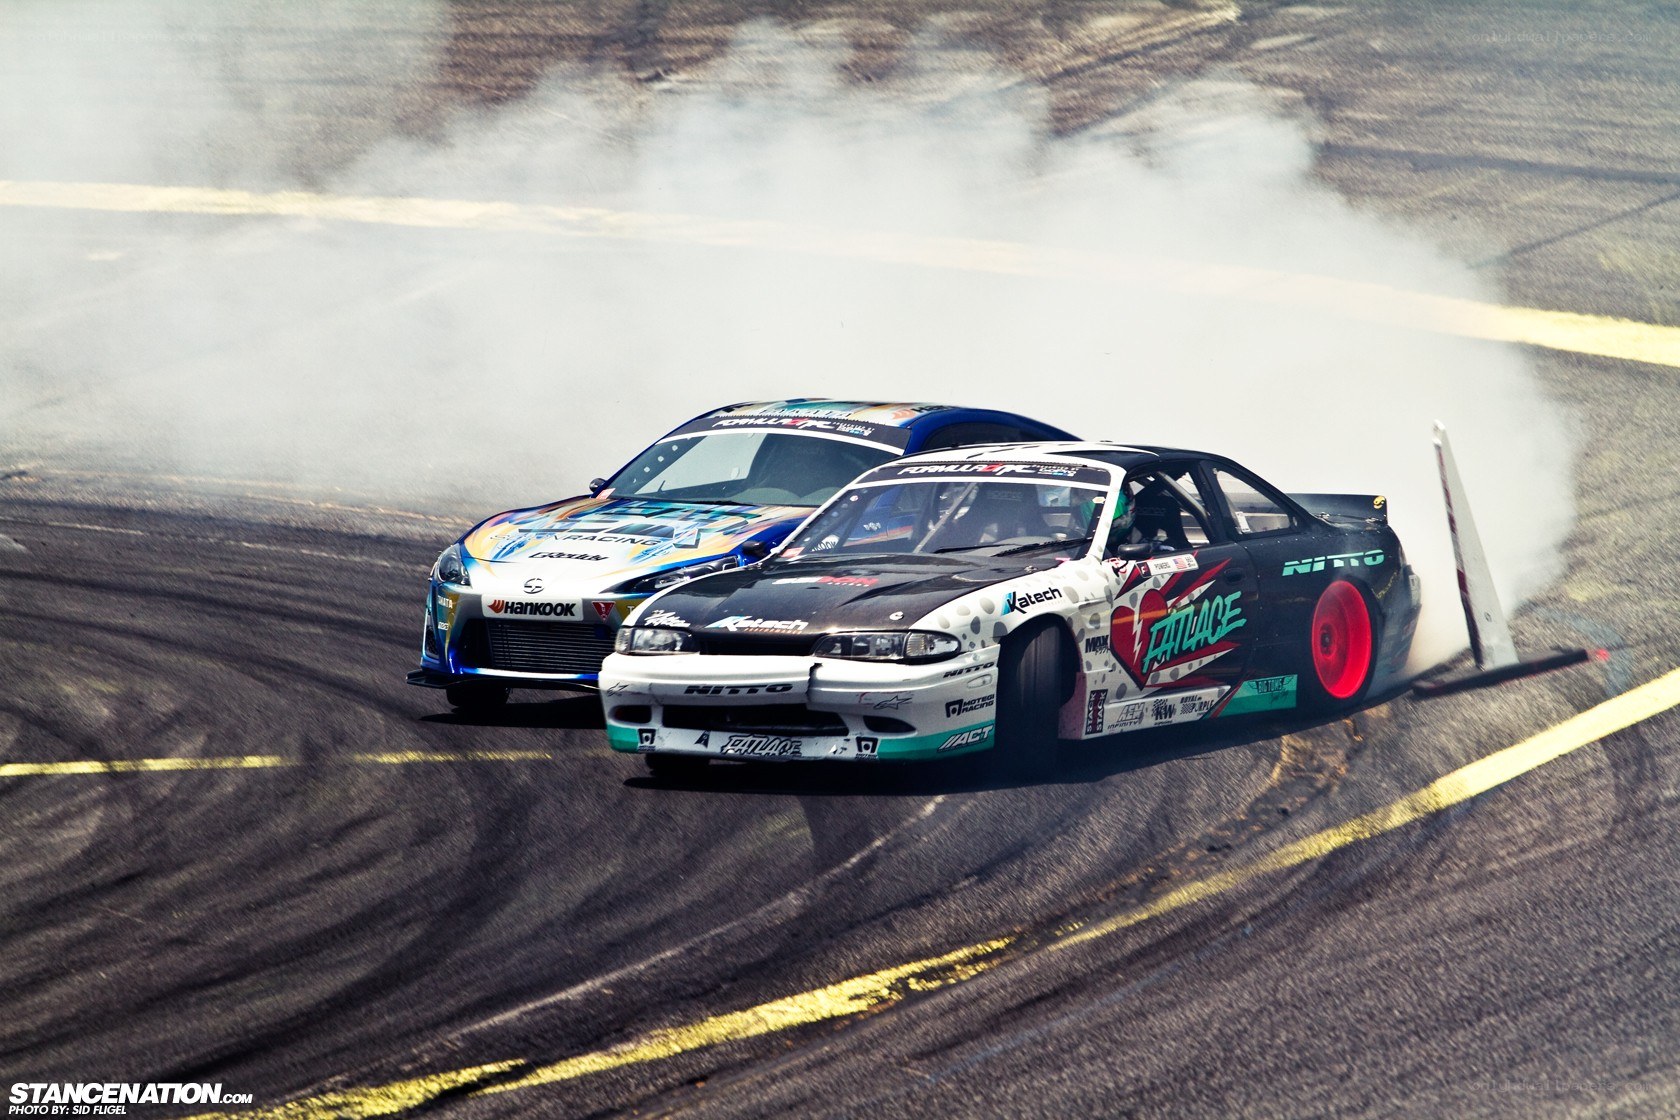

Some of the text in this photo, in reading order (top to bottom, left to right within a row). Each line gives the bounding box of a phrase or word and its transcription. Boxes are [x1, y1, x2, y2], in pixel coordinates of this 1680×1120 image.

[563, 534, 663, 547] RACING
[1282, 549, 1385, 577] NITTO
[1003, 586, 1063, 616] Katech
[716, 615, 809, 632] Katech
[1143, 590, 1247, 674] FATLACE
[1085, 634, 1110, 654] MAX
[942, 661, 995, 680] NITTO
[684, 683, 793, 695] NITTO
[961, 700, 995, 714] RACING
[963, 694, 995, 706] MOTEGI
[1180, 695, 1198, 704] ROYAL
[1086, 692, 1096, 733] STACK
[1096, 691, 1107, 732] STACK
[1117, 702, 1145, 723] AEM
[1107, 720, 1139, 730] INFINITY
